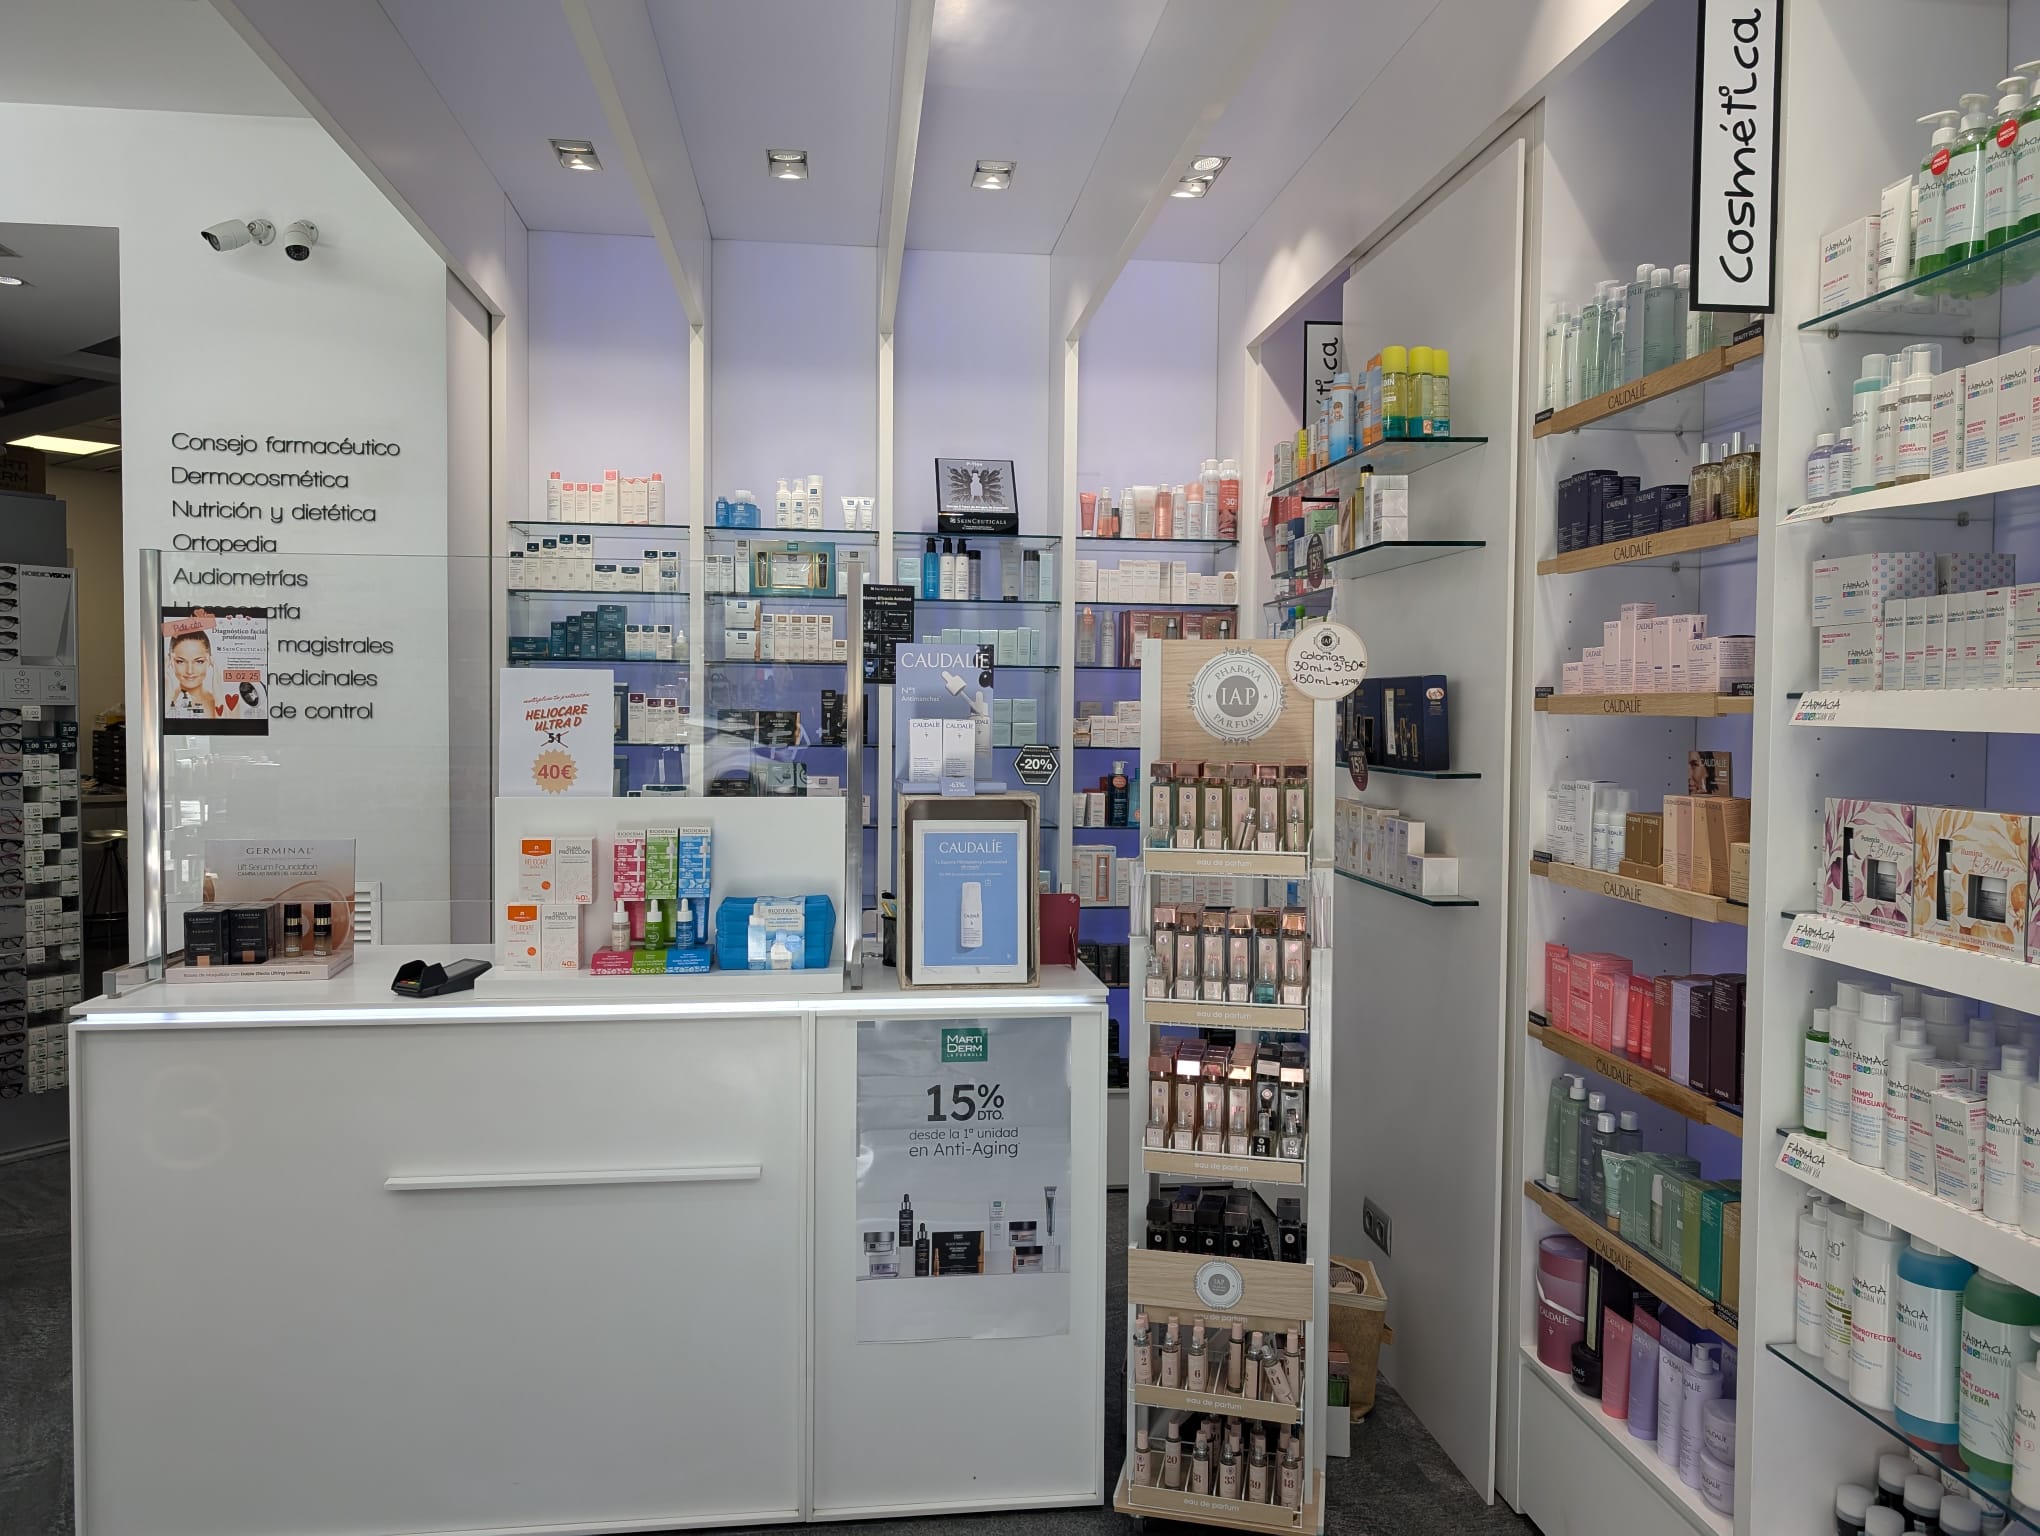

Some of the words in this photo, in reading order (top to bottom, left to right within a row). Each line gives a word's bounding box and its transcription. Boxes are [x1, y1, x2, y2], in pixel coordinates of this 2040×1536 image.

[1718, 8, 1762, 283] Cosmética
[171, 432, 258, 456] Consejo
[265, 435, 401, 457] farmacéutico
[171, 466, 349, 488] Dermocosmética
[172, 499, 262, 519] Nutrición
[270, 506, 283, 524] y
[291, 503, 376, 522] dietética
[172, 533, 277, 555] Ortopedia
[172, 567, 308, 587] Audiometrías
[277, 636, 394, 657] magistrales
[1300, 650, 1345, 663] Colonias
[225, 672, 233, 680] 13
[236, 672, 245, 680] 02
[250, 672, 259, 680] 25
[1214, 664, 1262, 683] PHARMA
[1221, 687, 1256, 706] IAP
[269, 702, 297, 719] de
[304, 702, 373, 719] control
[525, 703, 589, 721] HELIOCARE
[534, 718, 571, 732] ULTRA
[573, 716, 583, 727] D
[1212, 710, 1264, 729] PARFUMS
[537, 764, 572, 780] 40€
[1019, 759, 1053, 770] -20%
[246, 847, 312, 855] GERMINAL
[275, 863, 318, 871] Foundation
[946, 1034, 983, 1044] MARTI
[946, 1043, 983, 1053] DERM
[927, 1083, 1005, 1122] 15%
[977, 1110, 1004, 1121] DTO.
[909, 1129, 946, 1141] desde
[949, 1128, 960, 1140] la
[976, 1127, 1019, 1139] unidad
[908, 1144, 929, 1157] en
[1963, 1330, 2012, 1358] FARMACIA
[1970, 1393, 1990, 1408] VERA
[1974, 1385, 2000, 1401] DUCHA
[1200, 1397, 1212, 1406] de
[1214, 1400, 1242, 1411] parfum
[1166, 1455, 1178, 1465] 20
[1198, 1498, 1210, 1507] de
[1211, 1502, 1240, 1513] parfum
